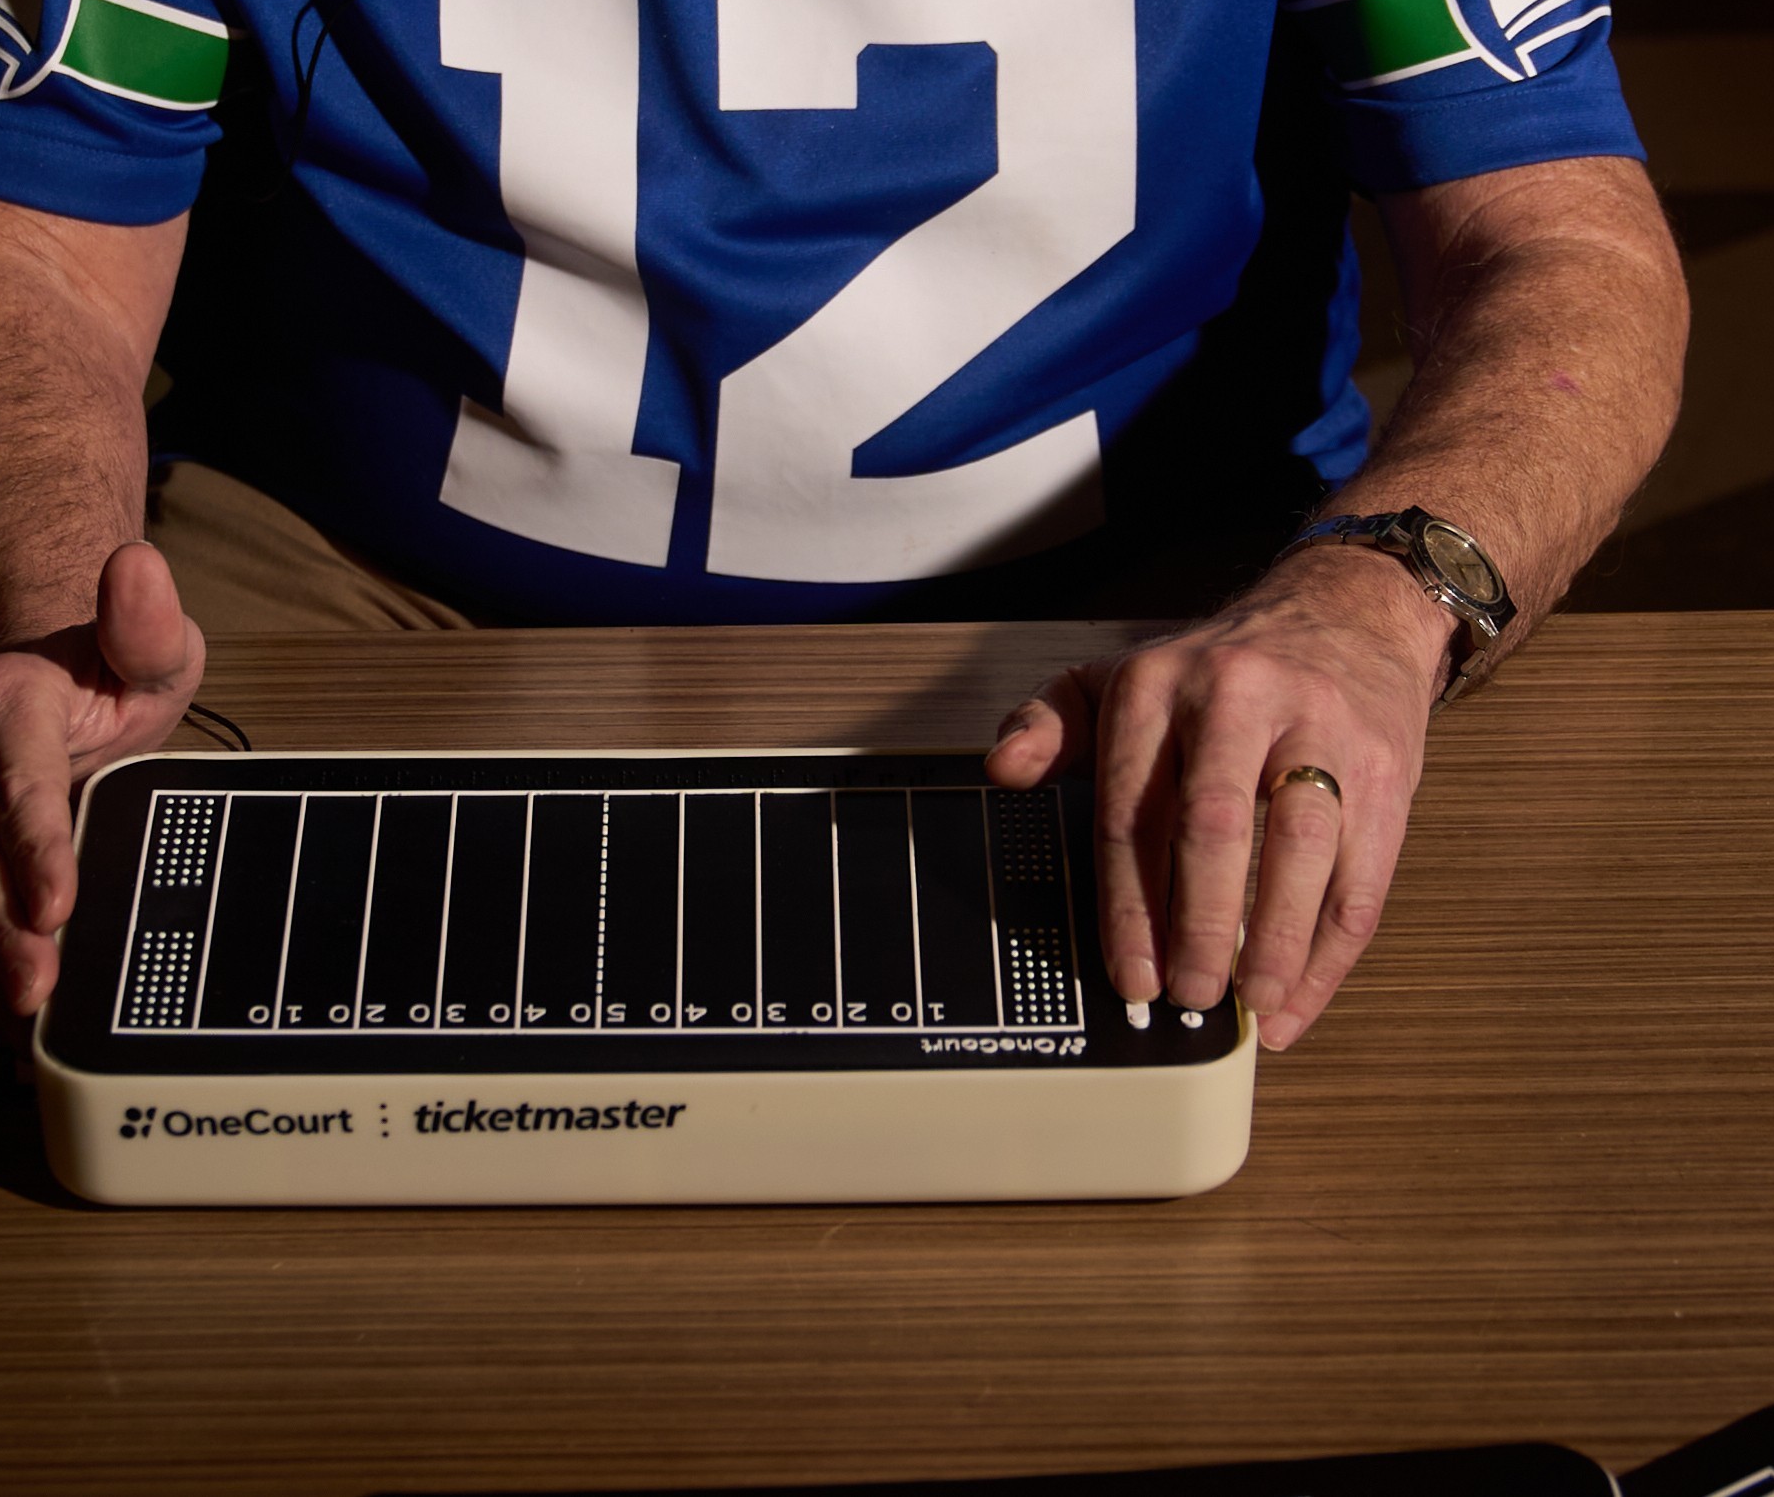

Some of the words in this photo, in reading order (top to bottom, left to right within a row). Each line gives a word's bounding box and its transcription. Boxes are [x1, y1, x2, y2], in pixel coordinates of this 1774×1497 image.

[920, 1036, 1056, 1055] OneCourt
[162, 1108, 354, 1138] OneCourt
[413, 1099, 687, 1135] ticketmaster
